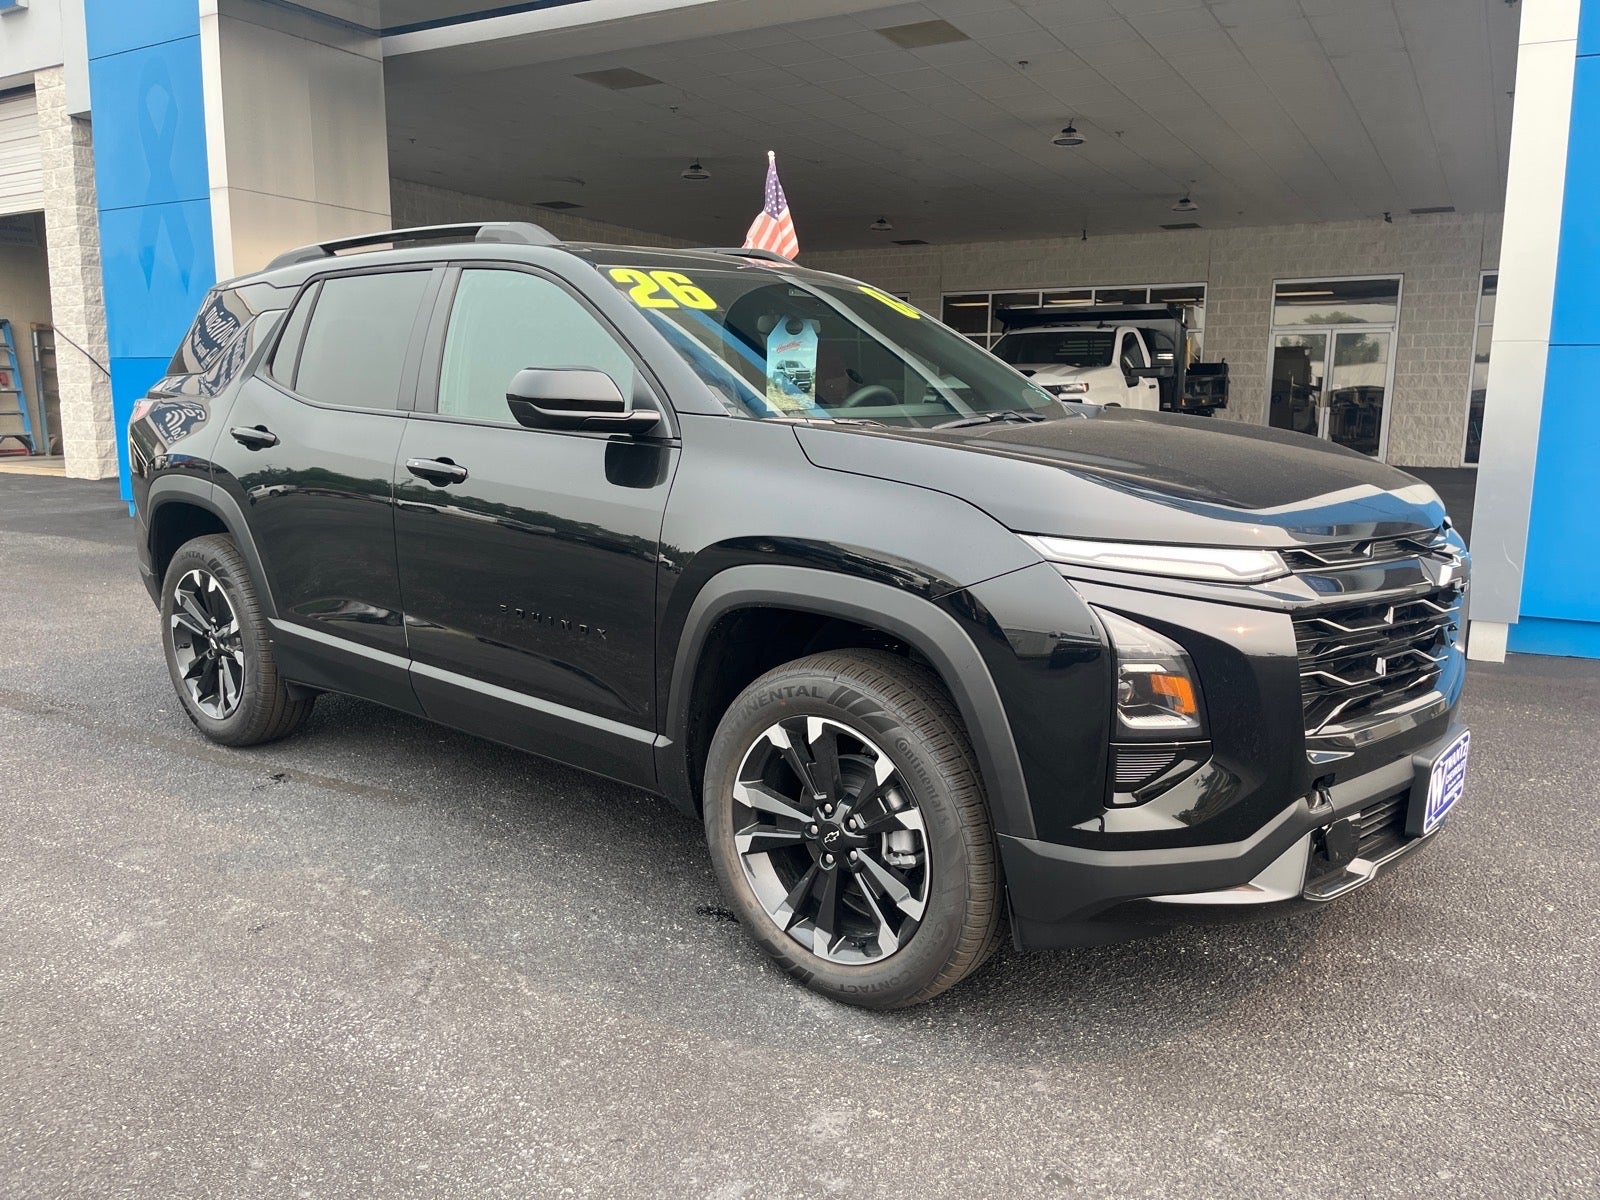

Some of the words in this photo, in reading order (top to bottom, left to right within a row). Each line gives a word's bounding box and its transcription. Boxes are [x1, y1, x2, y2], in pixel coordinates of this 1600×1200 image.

[608, 263, 718, 310] 26
[499, 603, 608, 640] EQUINOX
[895, 737, 946, 812] Continental
[840, 969, 912, 994] CONTACT
